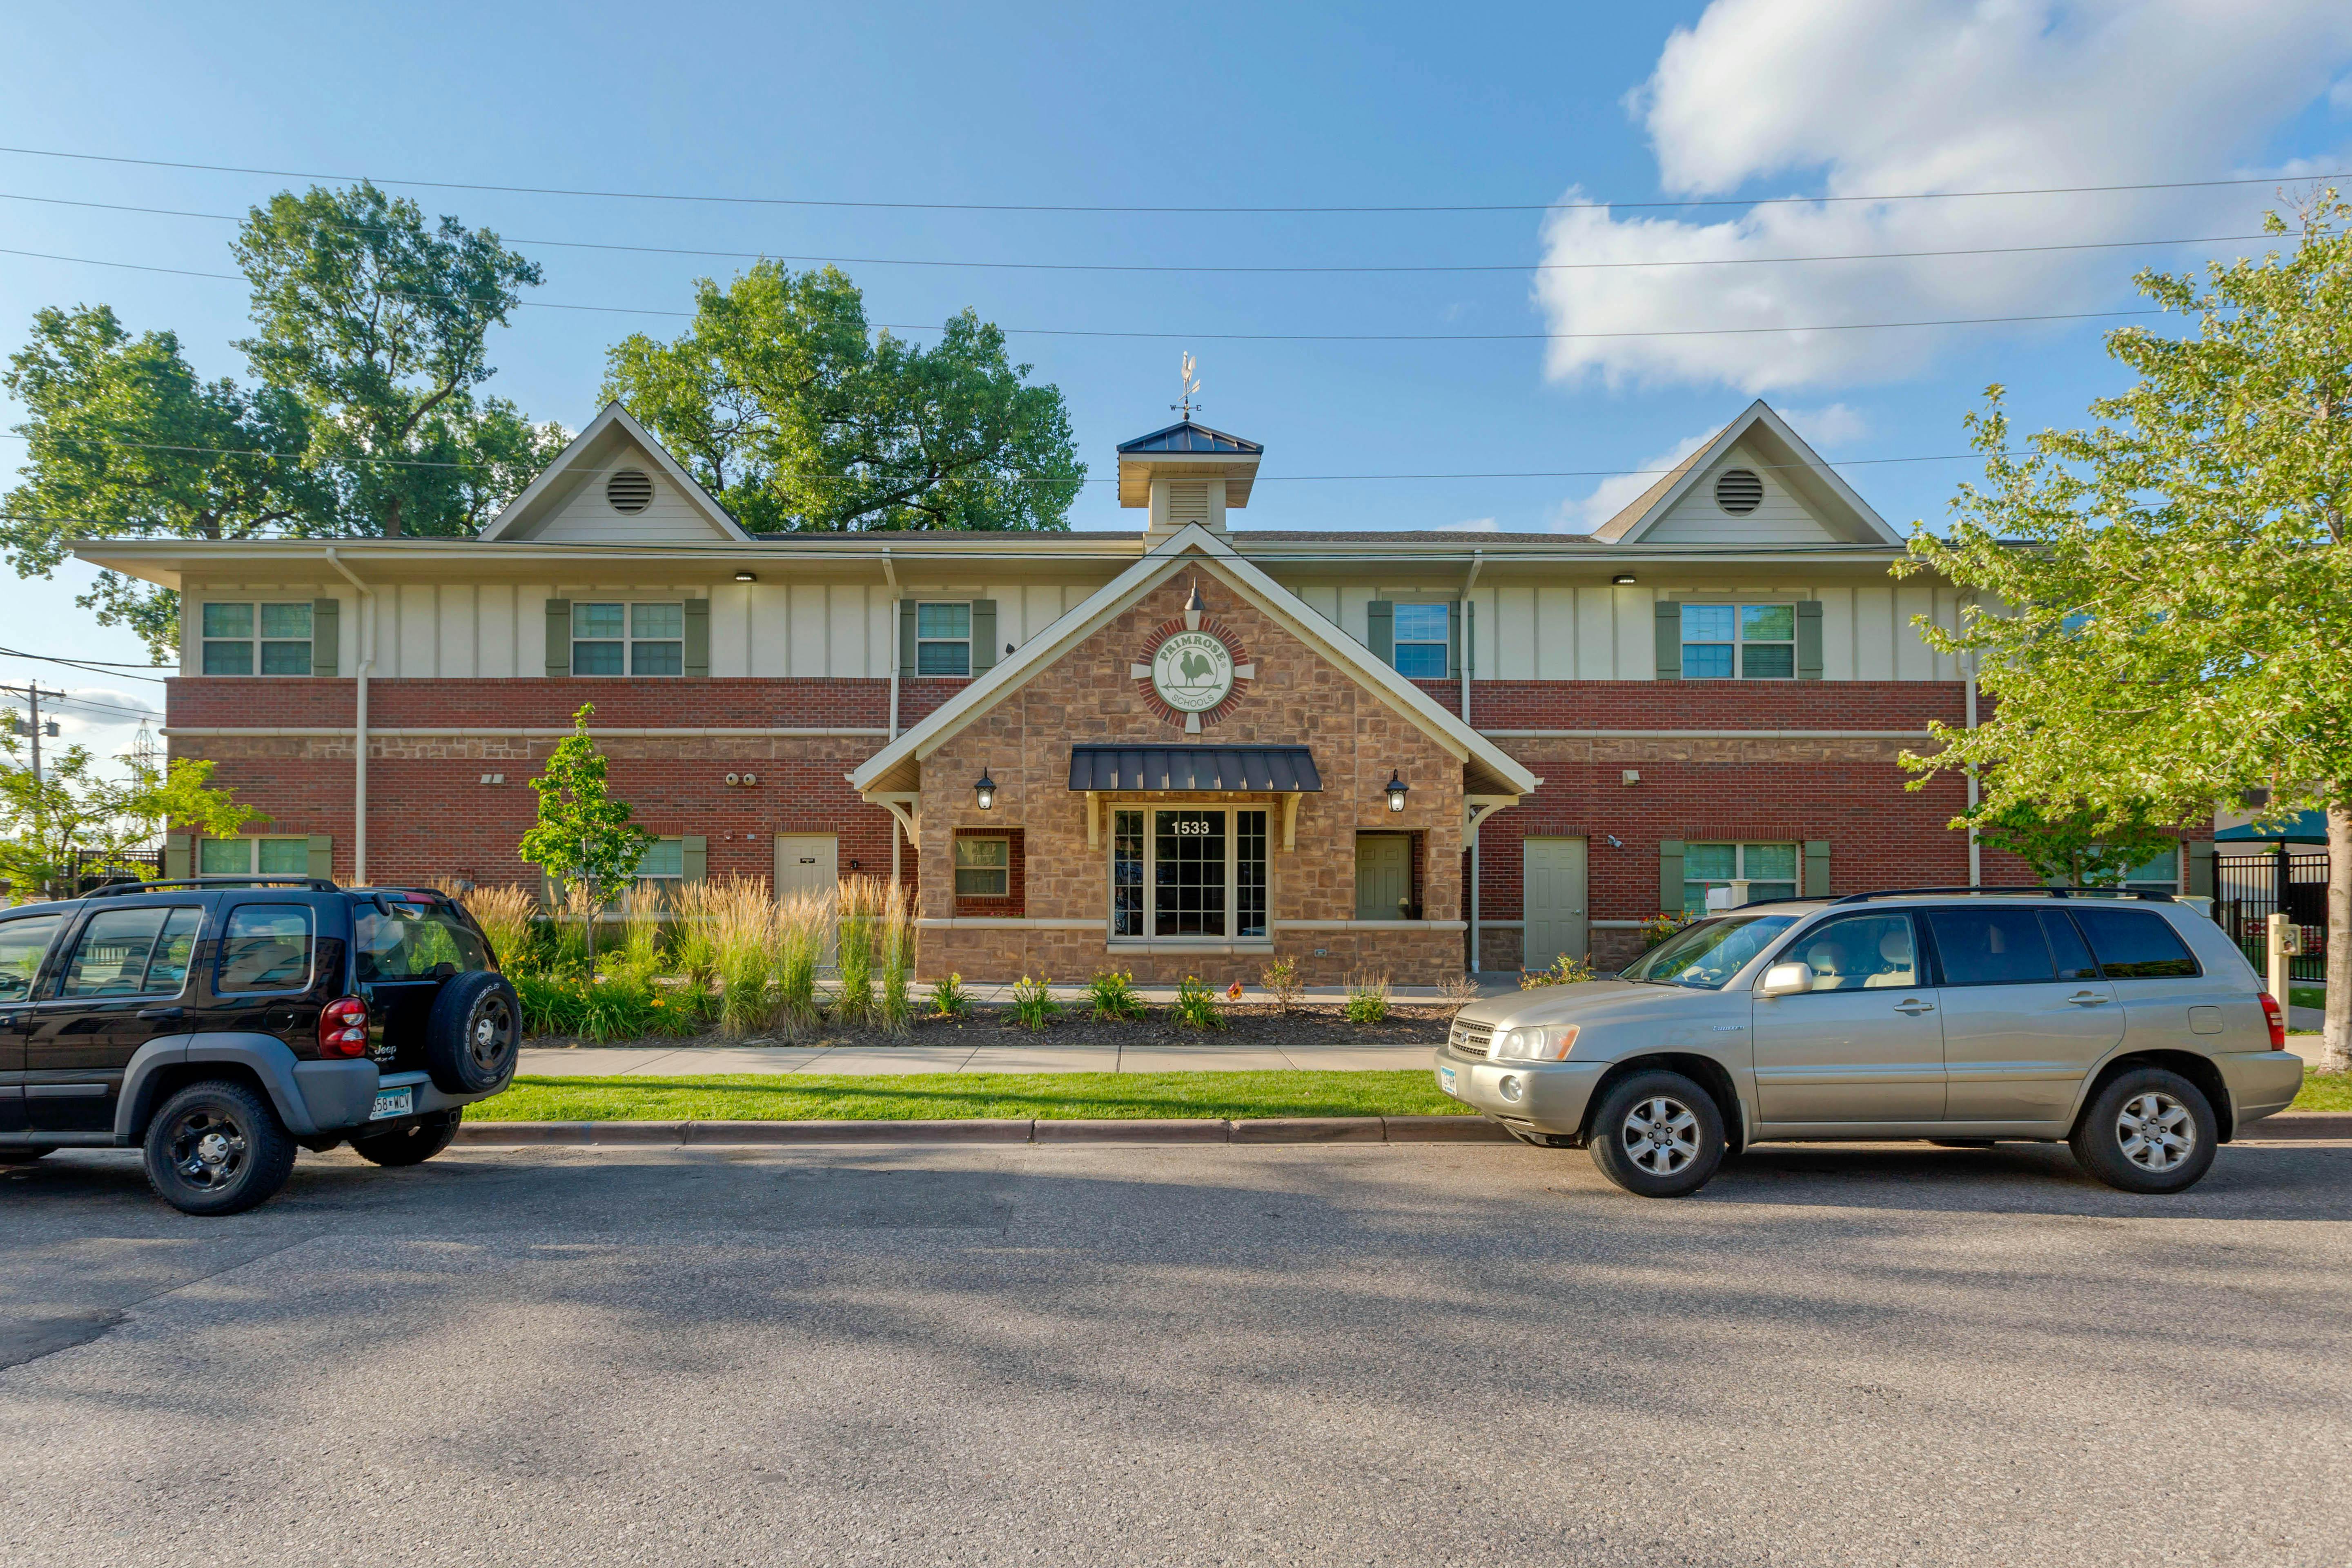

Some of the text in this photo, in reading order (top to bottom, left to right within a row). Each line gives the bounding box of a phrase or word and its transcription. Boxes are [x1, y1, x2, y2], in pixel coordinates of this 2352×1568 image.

[1159, 636, 1226, 662] PRIMROSE
[1172, 694, 1214, 707] SCHOOLS
[1172, 822, 1209, 834] 1533
[374, 1045, 396, 1055] Jeep
